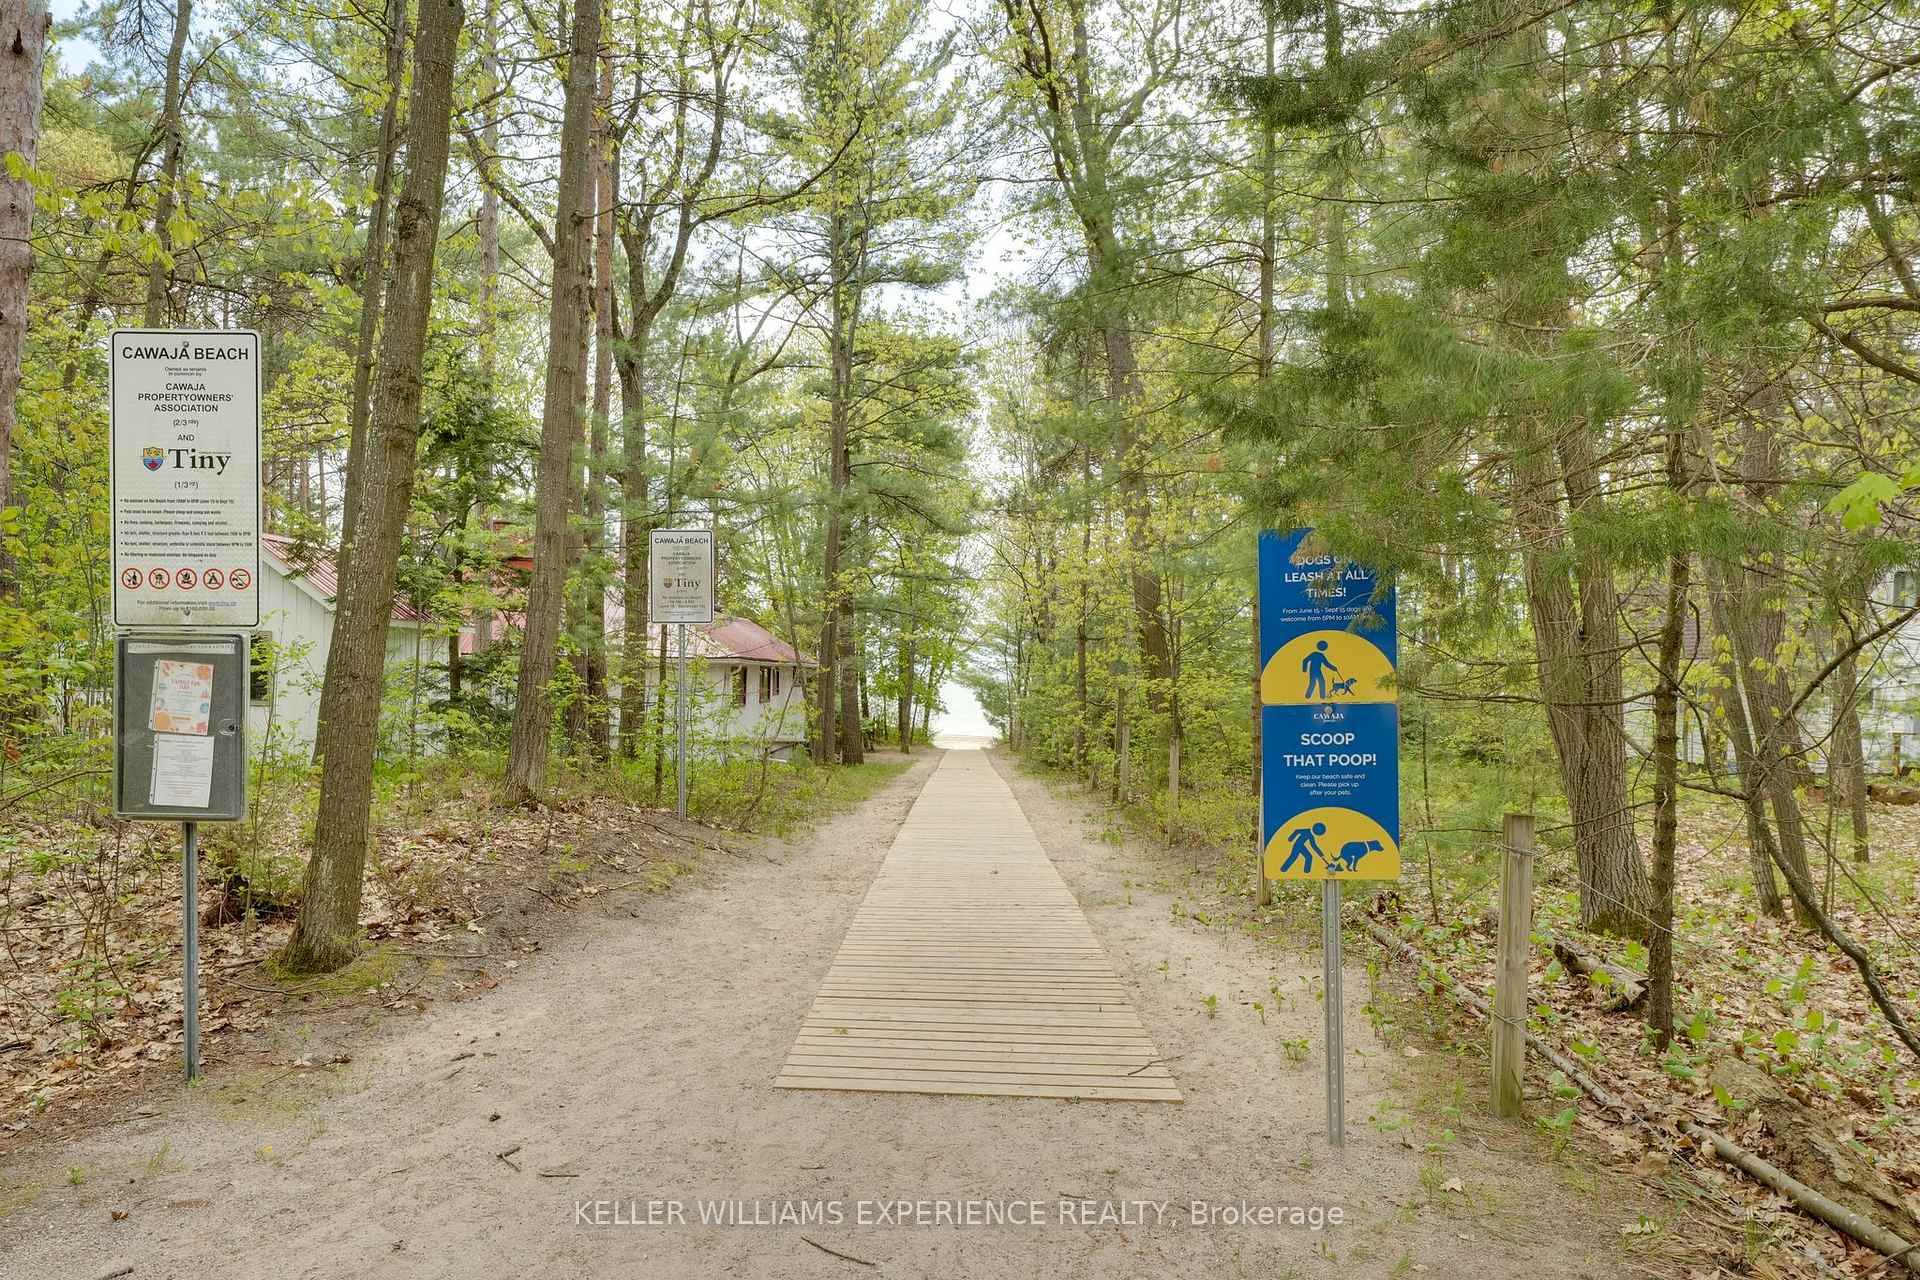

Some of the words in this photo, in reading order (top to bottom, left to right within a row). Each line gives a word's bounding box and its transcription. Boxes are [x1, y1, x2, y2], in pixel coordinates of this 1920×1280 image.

[122, 346, 190, 360] CAWAJA
[194, 347, 249, 360] BEACH
[165, 382, 206, 391] CAWAJA
[154, 403, 219, 412] ASSOCIATION
[177, 433, 195, 442] AND
[168, 448, 232, 476] Tiny
[654, 537, 683, 545] CAWAJA
[684, 537, 709, 545] BEACH
[1284, 571, 1324, 583] LEASH
[1345, 570, 1369, 580] ALL
[674, 578, 702, 590] Tiny
[1306, 587, 1347, 598] TIMES!
[1301, 733, 1355, 746] SCOOP
[1283, 754, 1325, 767] THAT
[1329, 753, 1377, 767] POOP!
